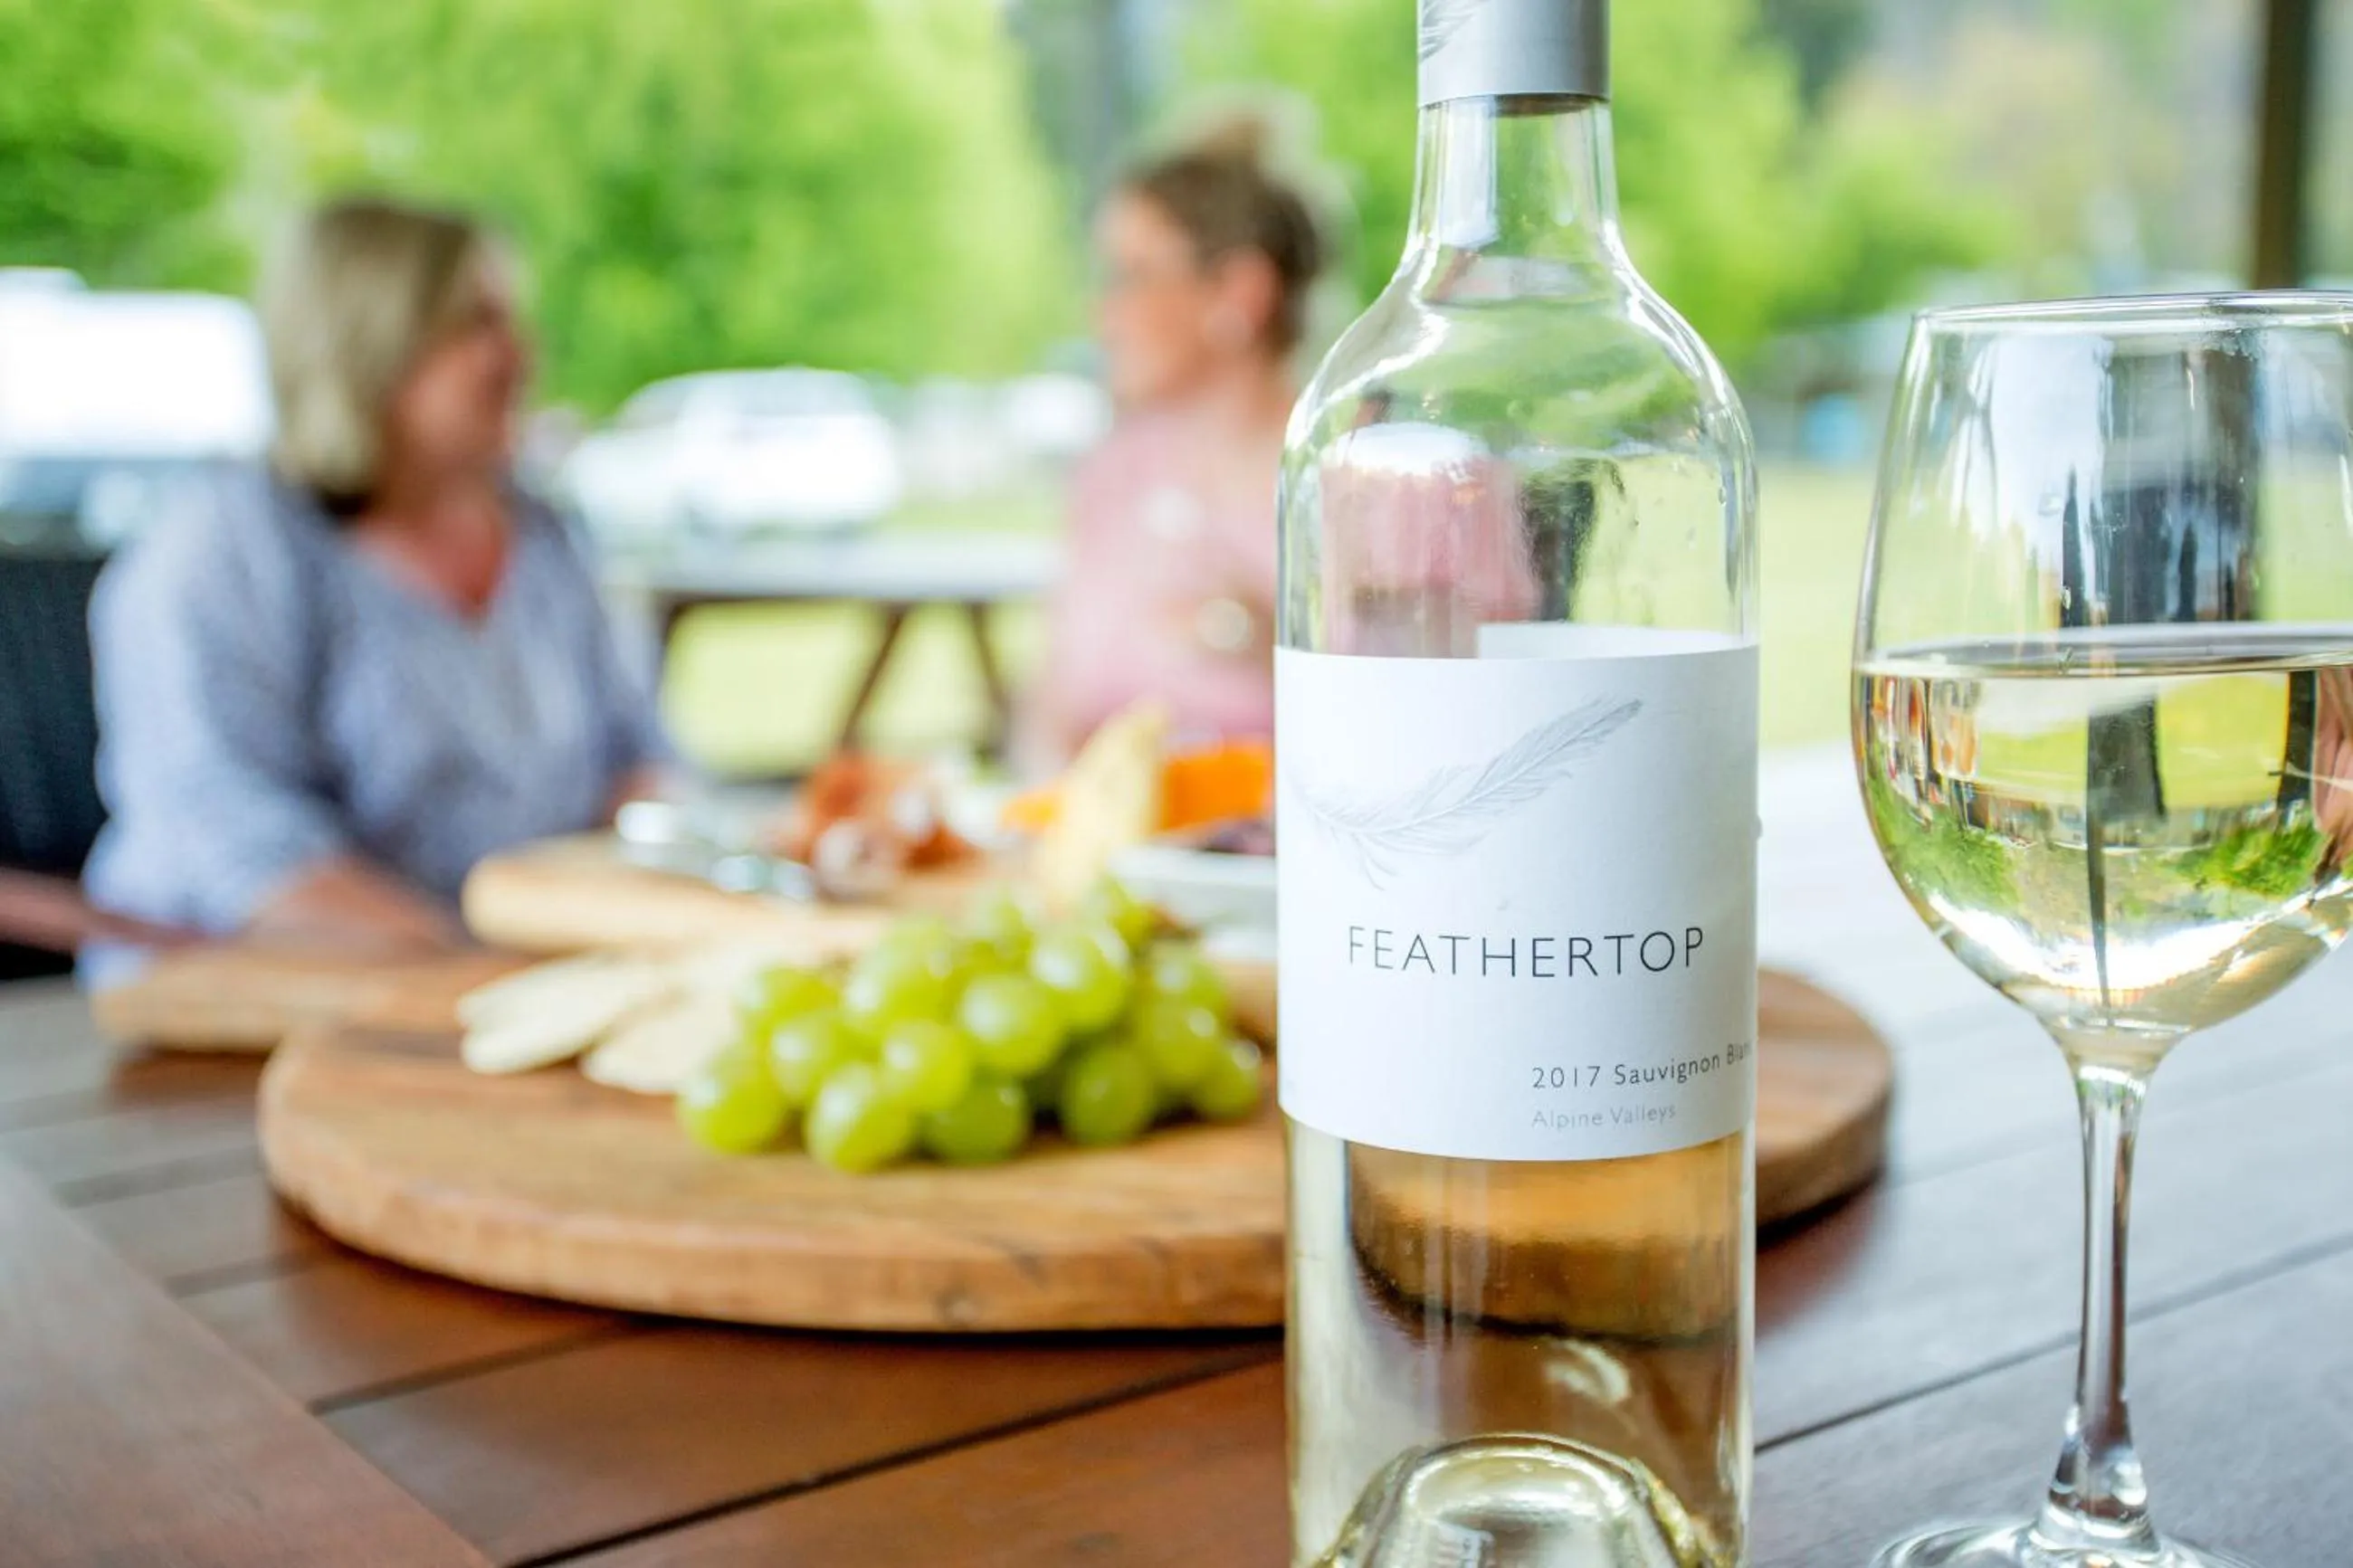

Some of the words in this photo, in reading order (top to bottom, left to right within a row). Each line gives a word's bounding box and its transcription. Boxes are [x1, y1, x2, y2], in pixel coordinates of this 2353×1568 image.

[1349, 926, 1703, 977] FEATHERTOP
[1532, 1066, 1601, 1089] 2017
[1614, 1053, 1720, 1085] Sauvignon
[1531, 1109, 1604, 1130] Alpine
[1610, 1103, 1676, 1126] Valleys
